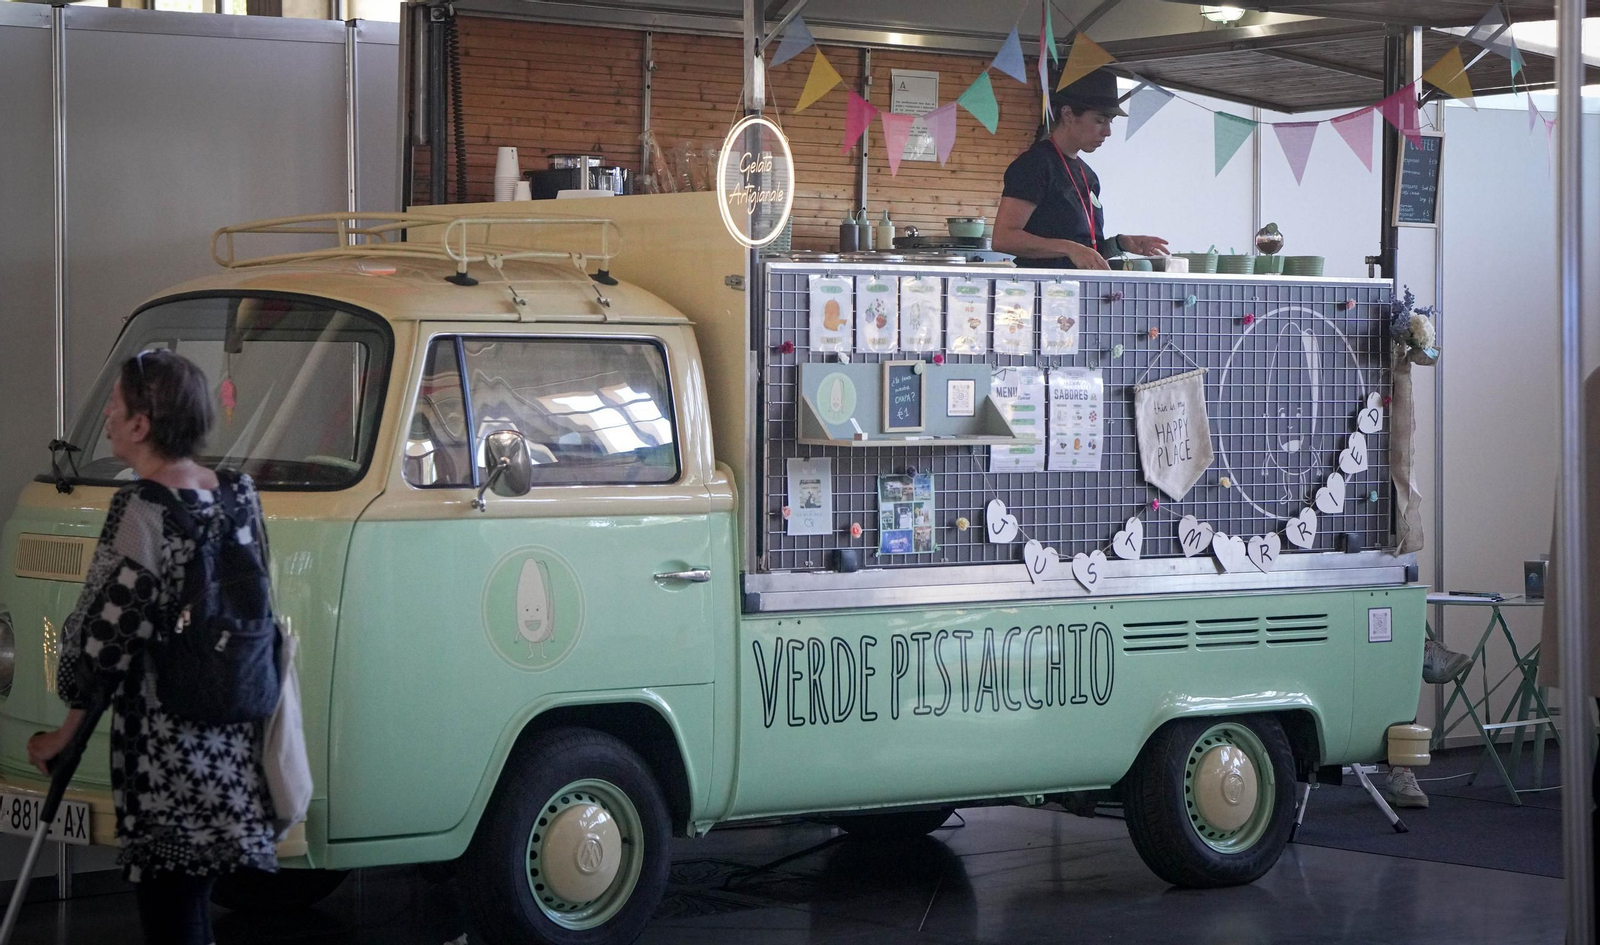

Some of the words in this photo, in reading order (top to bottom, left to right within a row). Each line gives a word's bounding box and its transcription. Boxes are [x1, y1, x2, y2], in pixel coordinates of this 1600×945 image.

[1410, 139, 1435, 151] CFEE
[740, 152, 772, 182] Gelato
[729, 182, 784, 215] Artigianale
[996, 387, 1018, 398] MENU
[1054, 389, 1089, 400] SABORES
[1154, 401, 1167, 415] this
[1170, 402, 1176, 410] is
[1177, 402, 1186, 416] my
[1155, 418, 1188, 443] HAPPY
[1158, 439, 1192, 469] PLACE
[752, 635, 878, 728] VERDE
[890, 622, 1115, 720] PISTACCHIO
